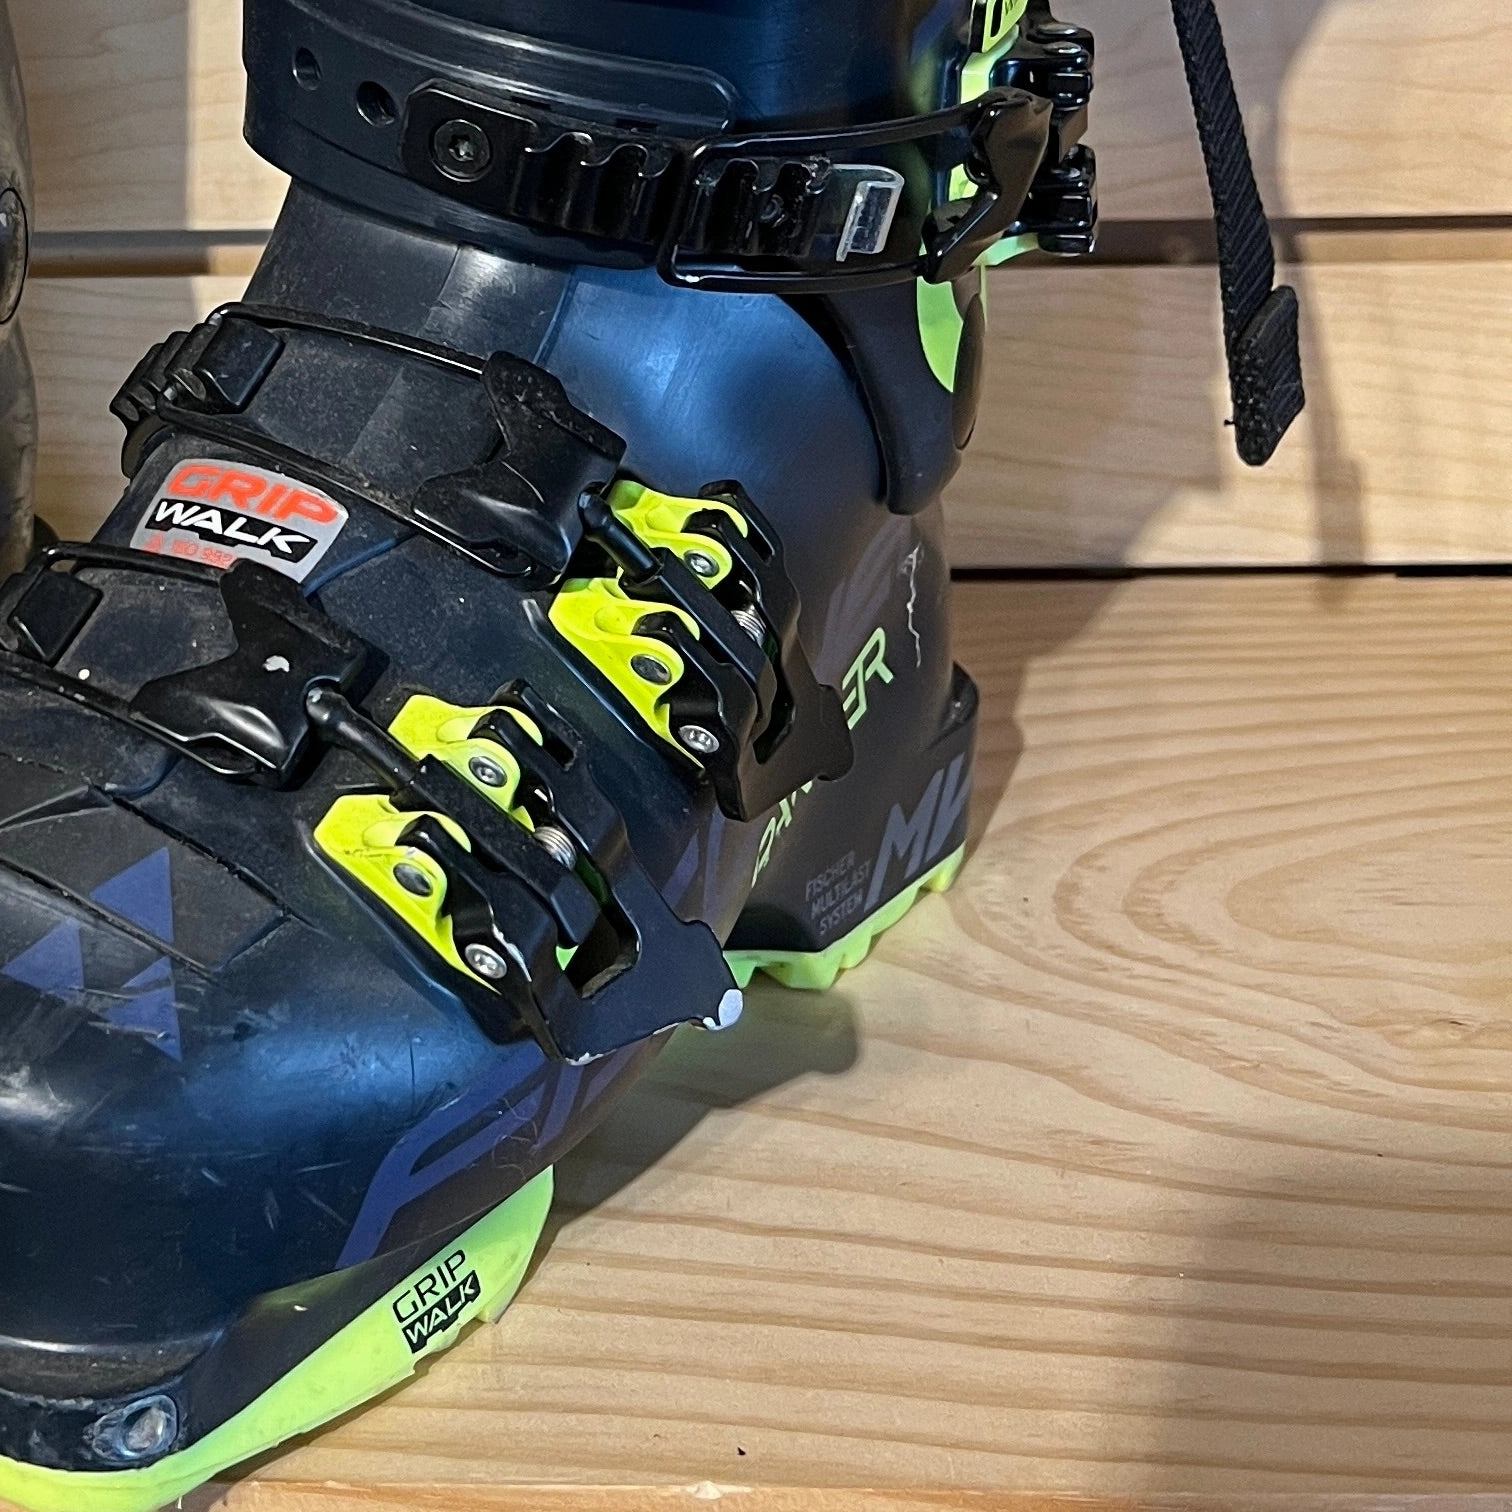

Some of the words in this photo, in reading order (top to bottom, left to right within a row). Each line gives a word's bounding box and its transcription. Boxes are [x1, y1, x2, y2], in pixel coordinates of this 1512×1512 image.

[154, 500, 311, 554] WALK
[167, 464, 340, 525] GRIP
[392, 1249, 467, 1324] GRIP
[405, 1276, 476, 1346] WALK
